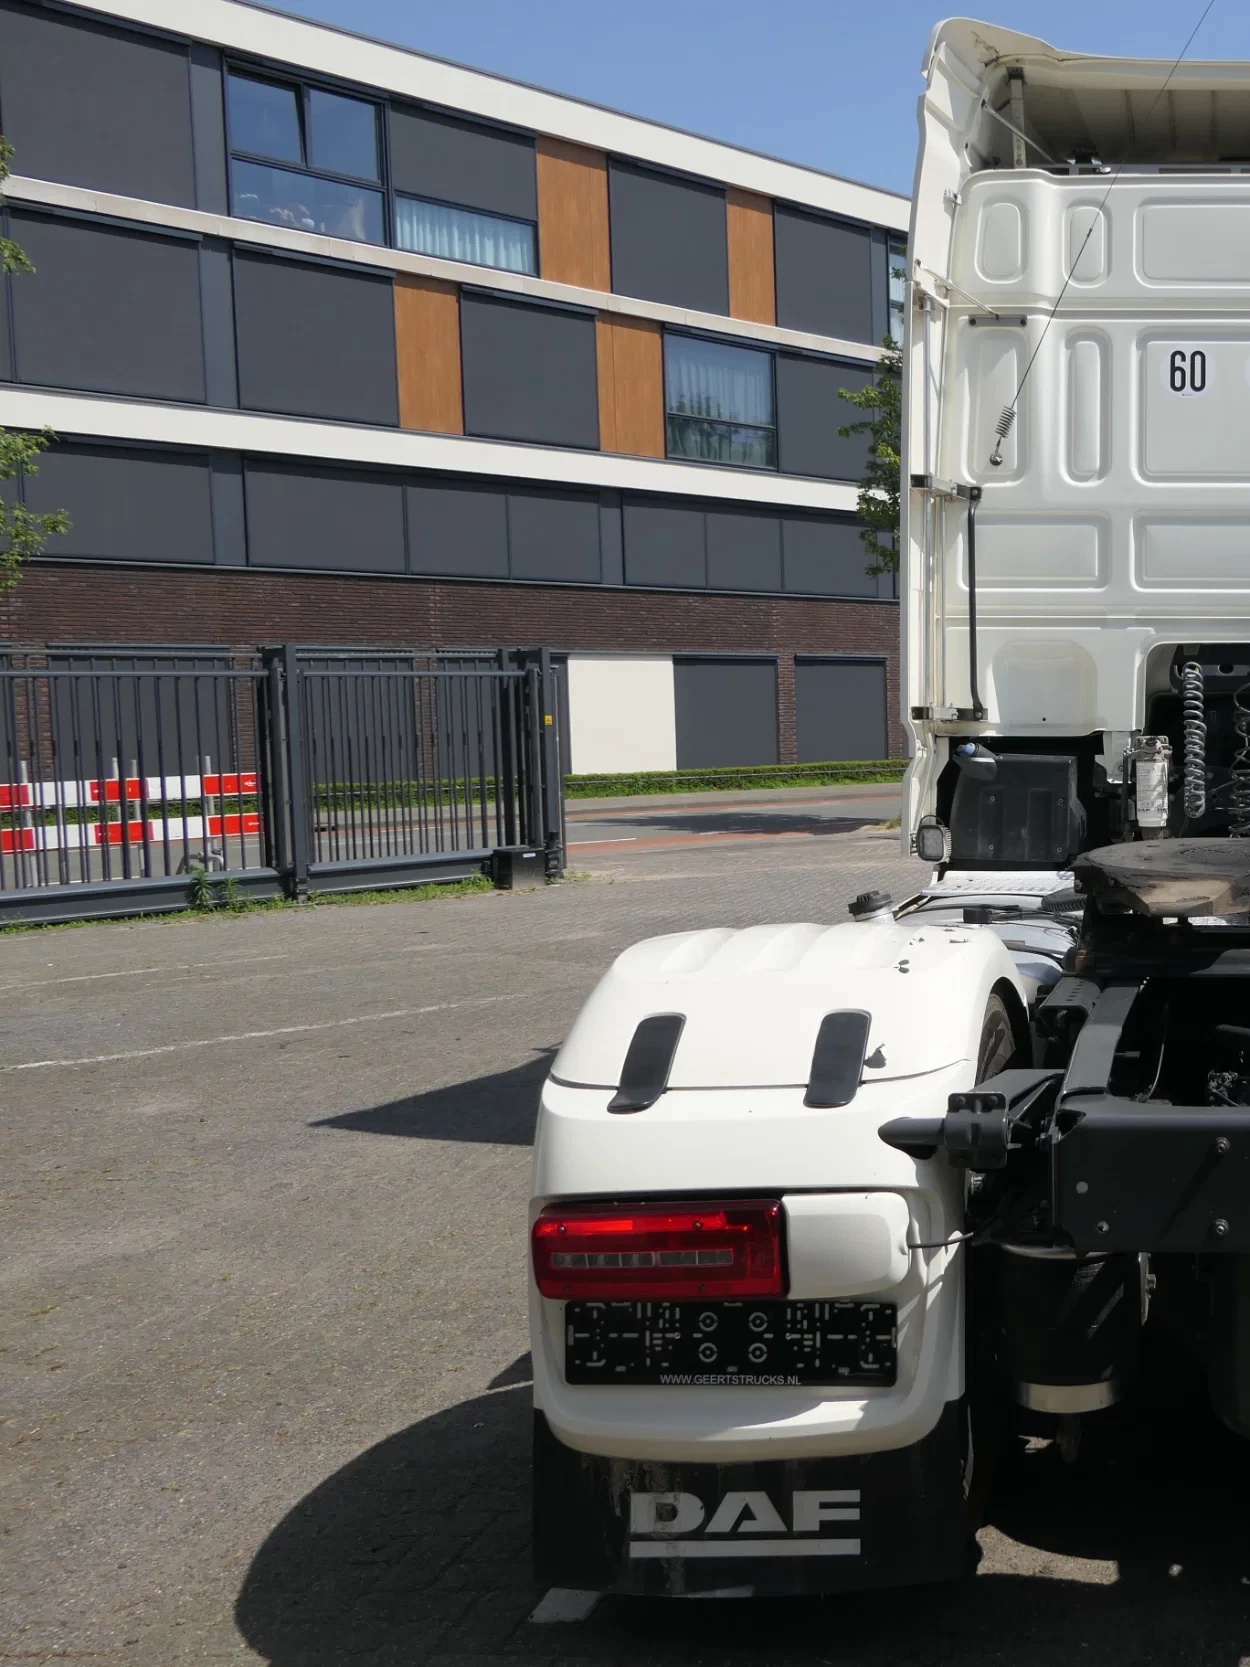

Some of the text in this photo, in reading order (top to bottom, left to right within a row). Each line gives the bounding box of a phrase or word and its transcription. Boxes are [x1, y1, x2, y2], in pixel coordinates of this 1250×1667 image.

[1169, 350, 1206, 392] 60
[659, 1374, 802, 1386] WWW.GEERTSTRUCKS.NL
[630, 1489, 861, 1533] DAF
